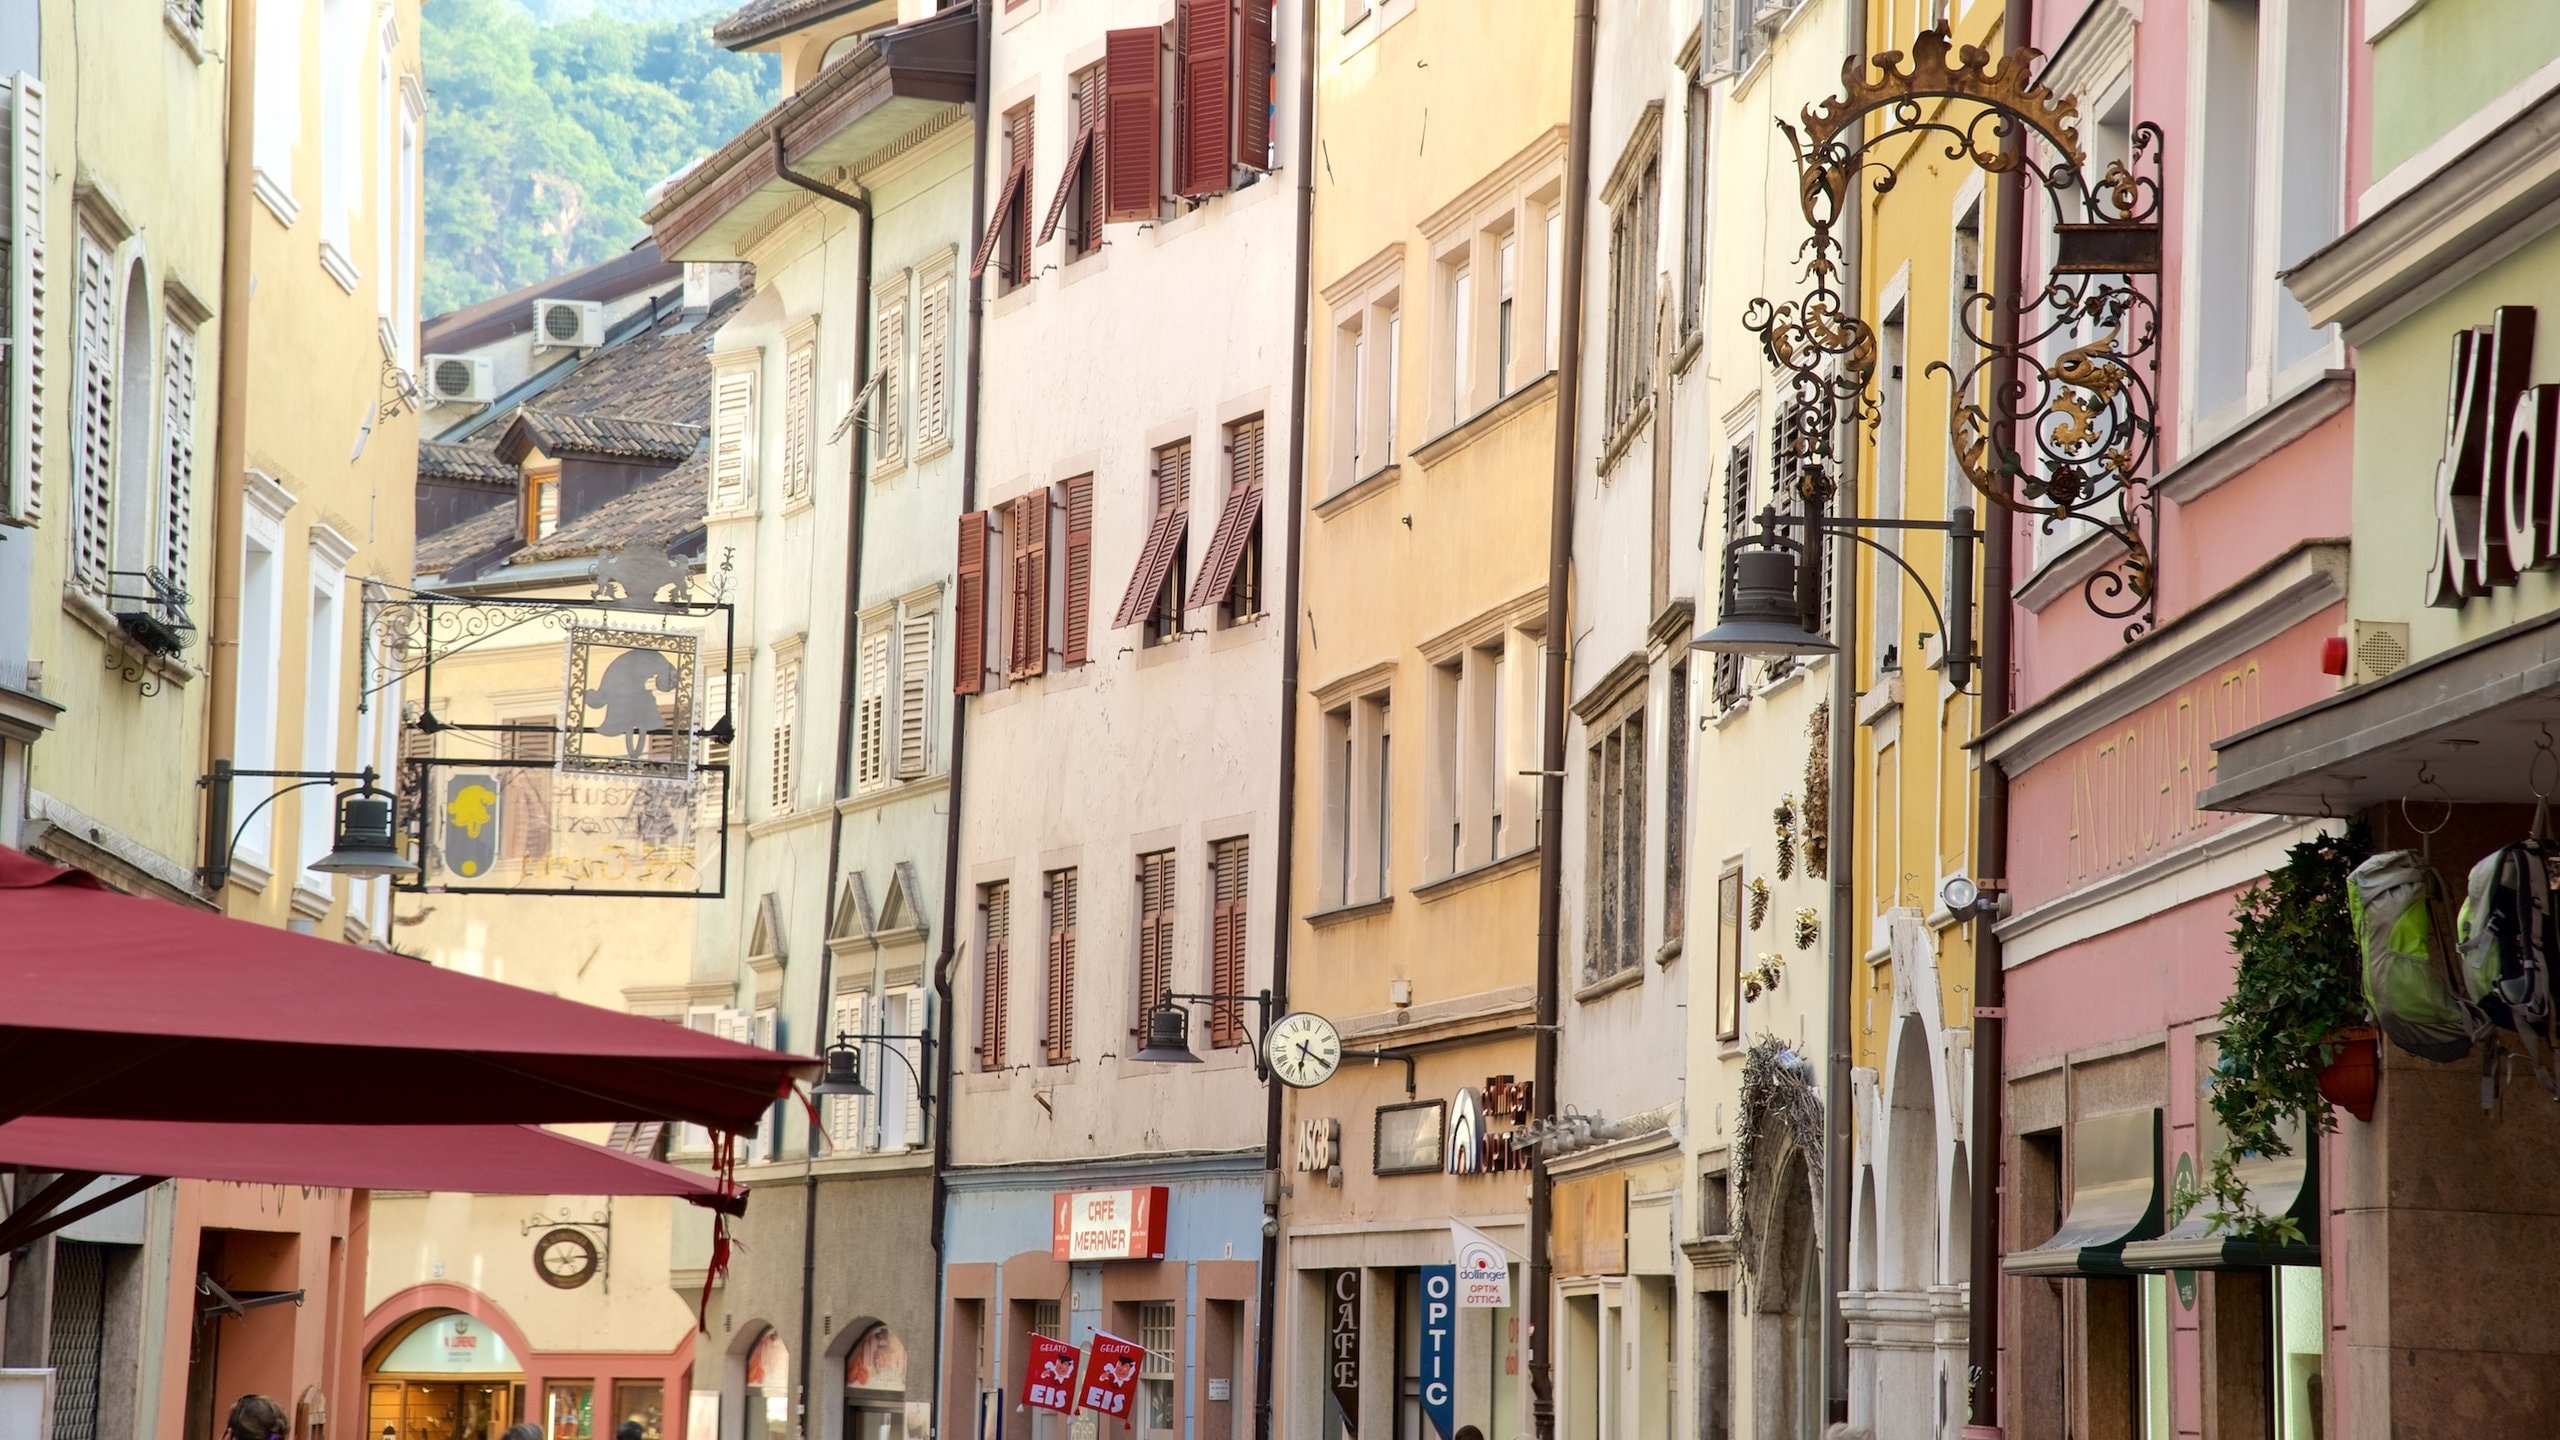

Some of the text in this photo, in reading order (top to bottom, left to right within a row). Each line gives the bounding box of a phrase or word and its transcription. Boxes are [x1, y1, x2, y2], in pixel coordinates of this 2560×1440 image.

[1297, 1118, 1336, 1172] ASGB
[1074, 1229, 1126, 1252] MERANER
[1459, 1269, 1506, 1281] dollinger
[1467, 1295, 1502, 1304] OTTICA
[1470, 1284, 1499, 1293] OPTIK
[1332, 1271, 1358, 1388] CAFE
[1425, 1275, 1449, 1406] OPTIC
[1040, 1343, 1068, 1353] GELATO
[1100, 1343, 1130, 1354] GELATO
[1029, 1383, 1067, 1409] EIS
[1086, 1386, 1126, 1414] EIS
